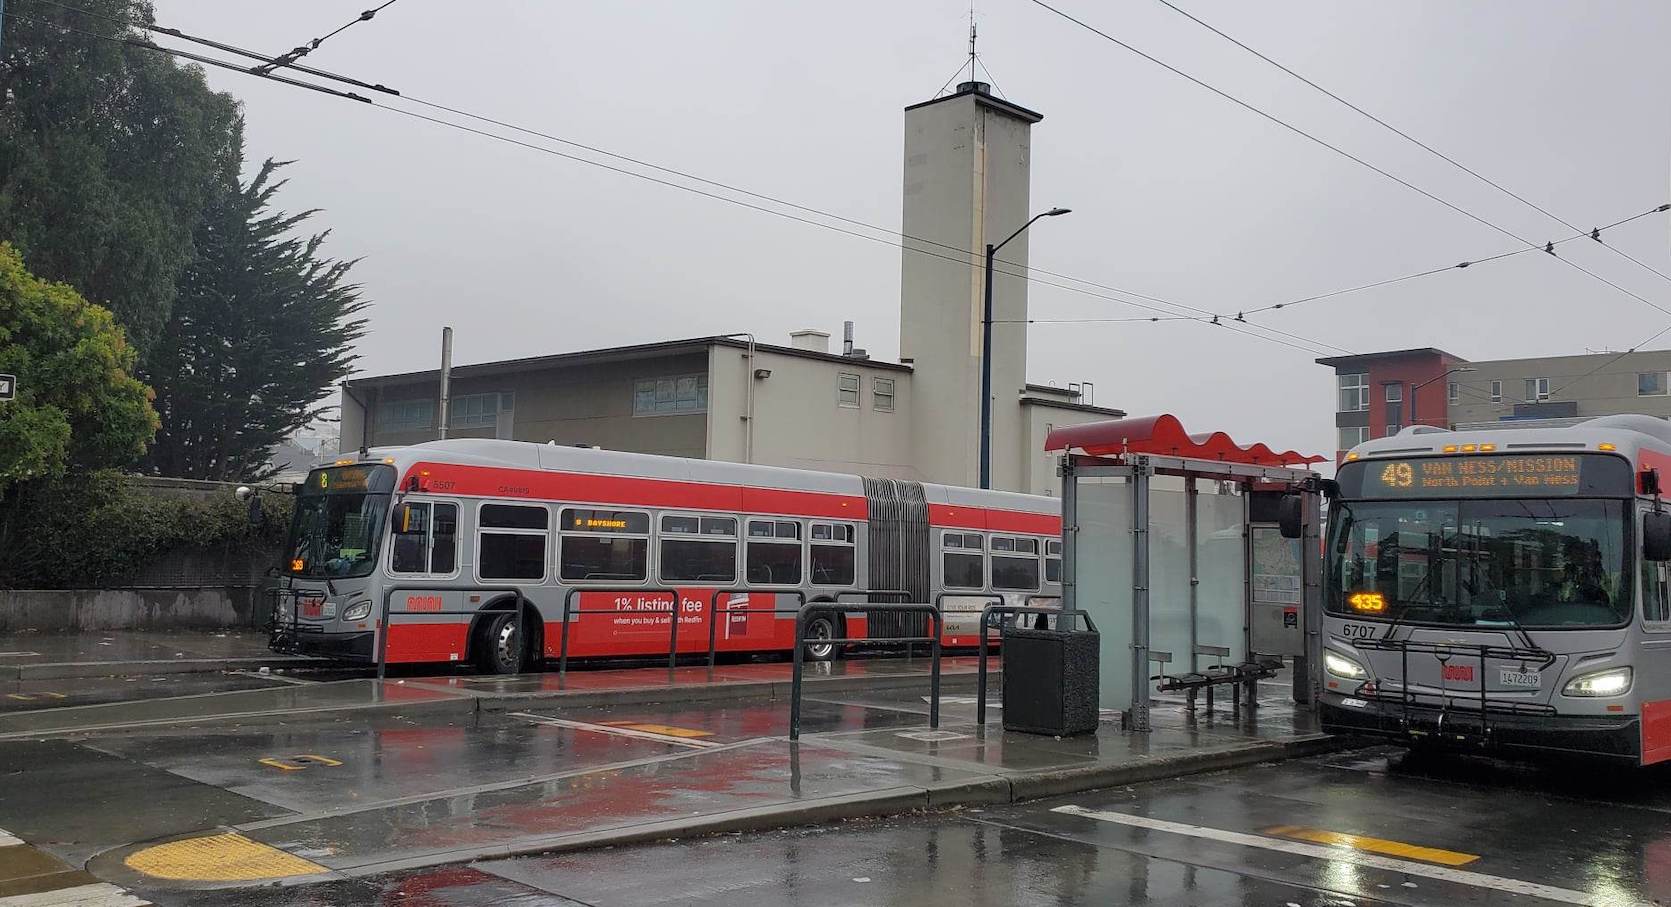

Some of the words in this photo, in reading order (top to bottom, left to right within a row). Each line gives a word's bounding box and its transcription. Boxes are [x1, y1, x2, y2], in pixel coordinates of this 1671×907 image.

[321, 472, 328, 488] 8
[1381, 463, 1414, 487] 49
[1422, 463, 1451, 475] VAN
[1459, 458, 1576, 474] NESS/MISSION
[588, 519, 627, 528] BAYSHORE
[614, 597, 633, 611] 1%
[681, 597, 703, 612] fee
[1350, 593, 1384, 610] 435
[631, 617, 640, 626] you
[643, 616, 655, 626] buy
[1343, 624, 1376, 639] 6707
[1503, 673, 1538, 685] 1472209
